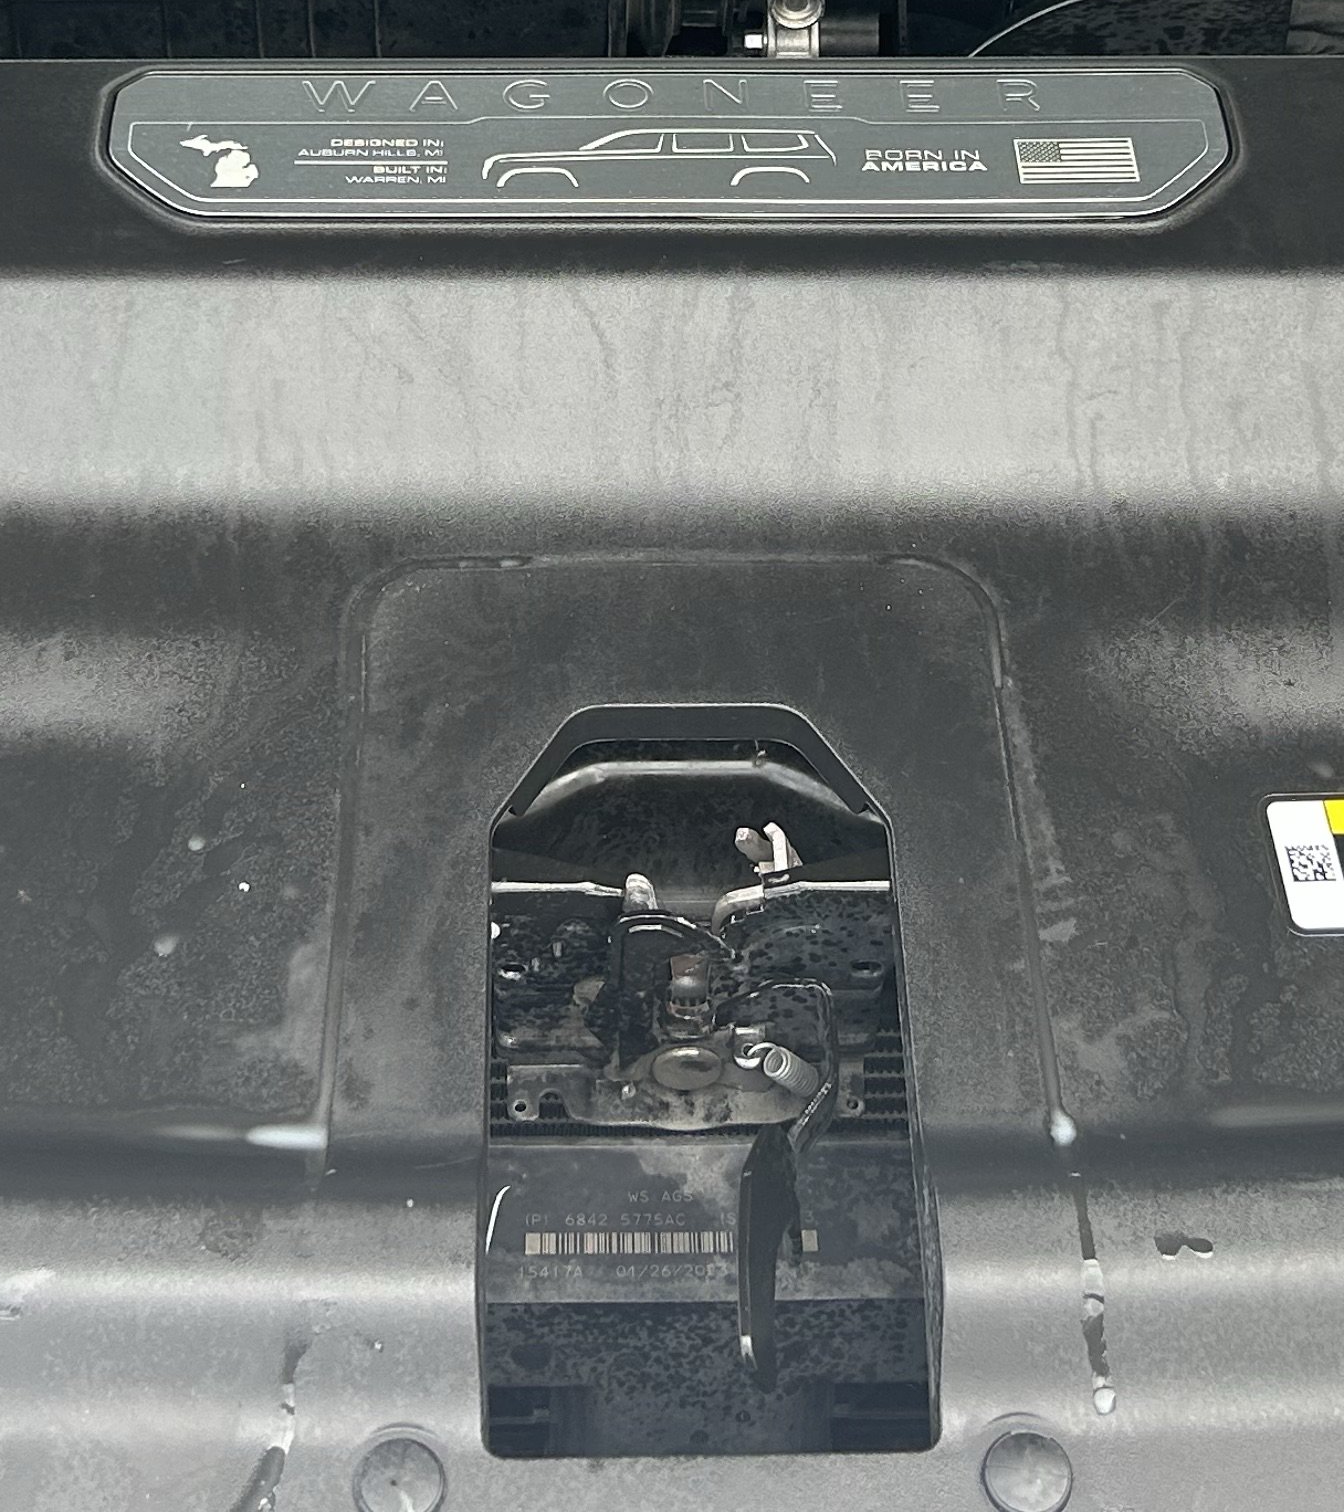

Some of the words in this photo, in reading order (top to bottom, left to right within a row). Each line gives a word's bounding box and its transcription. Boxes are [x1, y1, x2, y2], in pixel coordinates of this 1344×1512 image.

[301, 79, 1041, 113] WAGONEER
[331, 139, 418, 147] DESIGNED
[298, 149, 368, 157] AUBURN
[372, 149, 420, 157] HILLS,
[865, 149, 942, 160] BORN
[954, 149, 979, 160] IN
[373, 166, 420, 174] BUILT
[862, 161, 987, 171] AMERICA
[346, 176, 422, 184] WARREN,
[628, 1191, 649, 1203] WS
[661, 1191, 693, 1202] AGS
[525, 1214, 548, 1226] (P)
[565, 1214, 608, 1226] 6842
[620, 1214, 686, 1226] 5775AC
